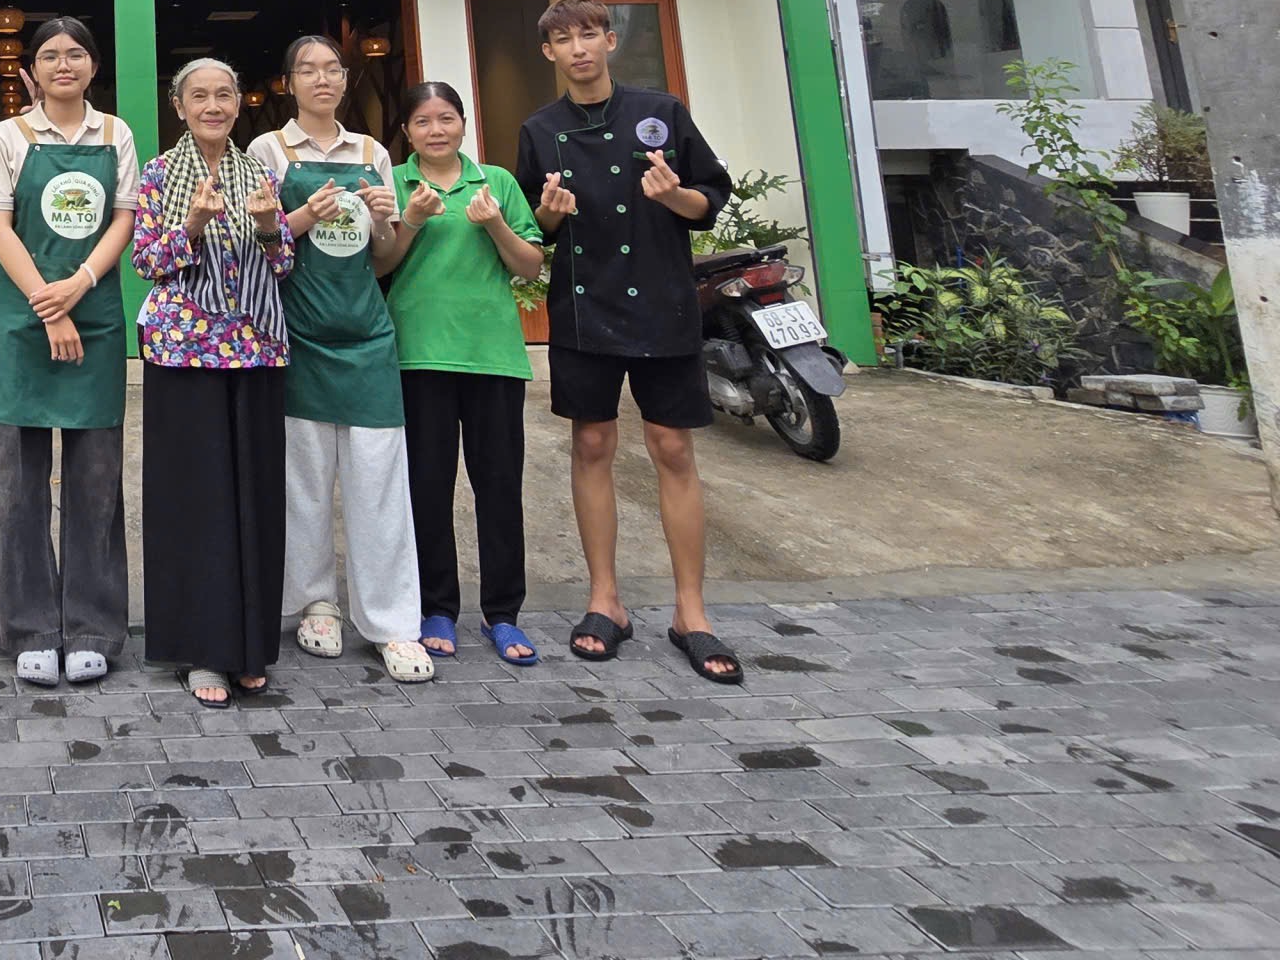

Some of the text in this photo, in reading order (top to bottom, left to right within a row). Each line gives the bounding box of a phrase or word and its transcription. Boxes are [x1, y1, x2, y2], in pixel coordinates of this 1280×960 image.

[51, 210, 97, 224] MẠ TÔI
[341, 229, 362, 241] TÔI
